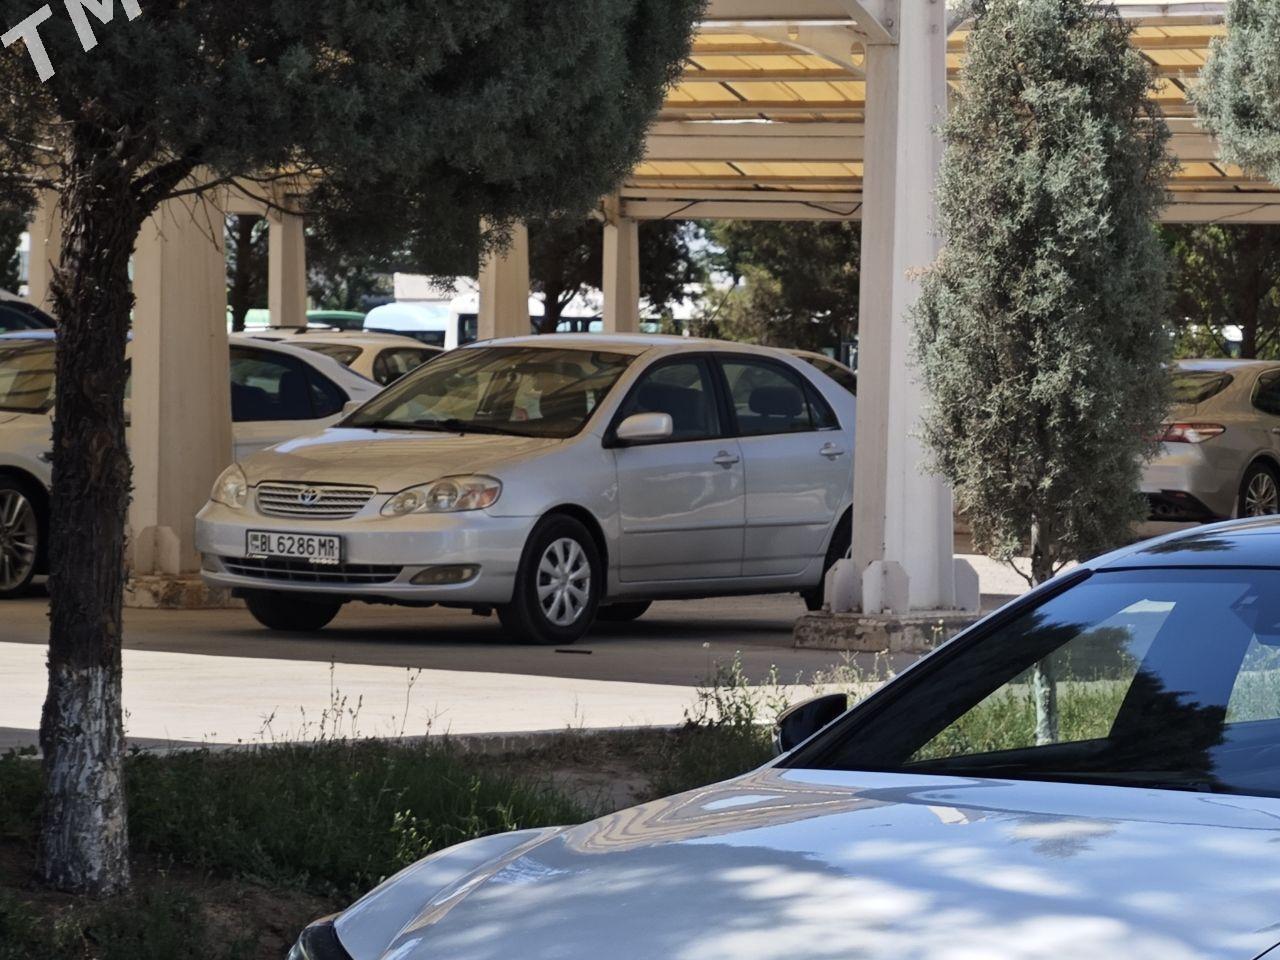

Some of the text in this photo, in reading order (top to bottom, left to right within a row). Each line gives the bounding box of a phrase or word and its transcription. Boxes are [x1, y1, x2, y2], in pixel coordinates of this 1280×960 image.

[260, 534, 274, 553] BL
[277, 536, 315, 556] 6286
[318, 538, 335, 557] MR
